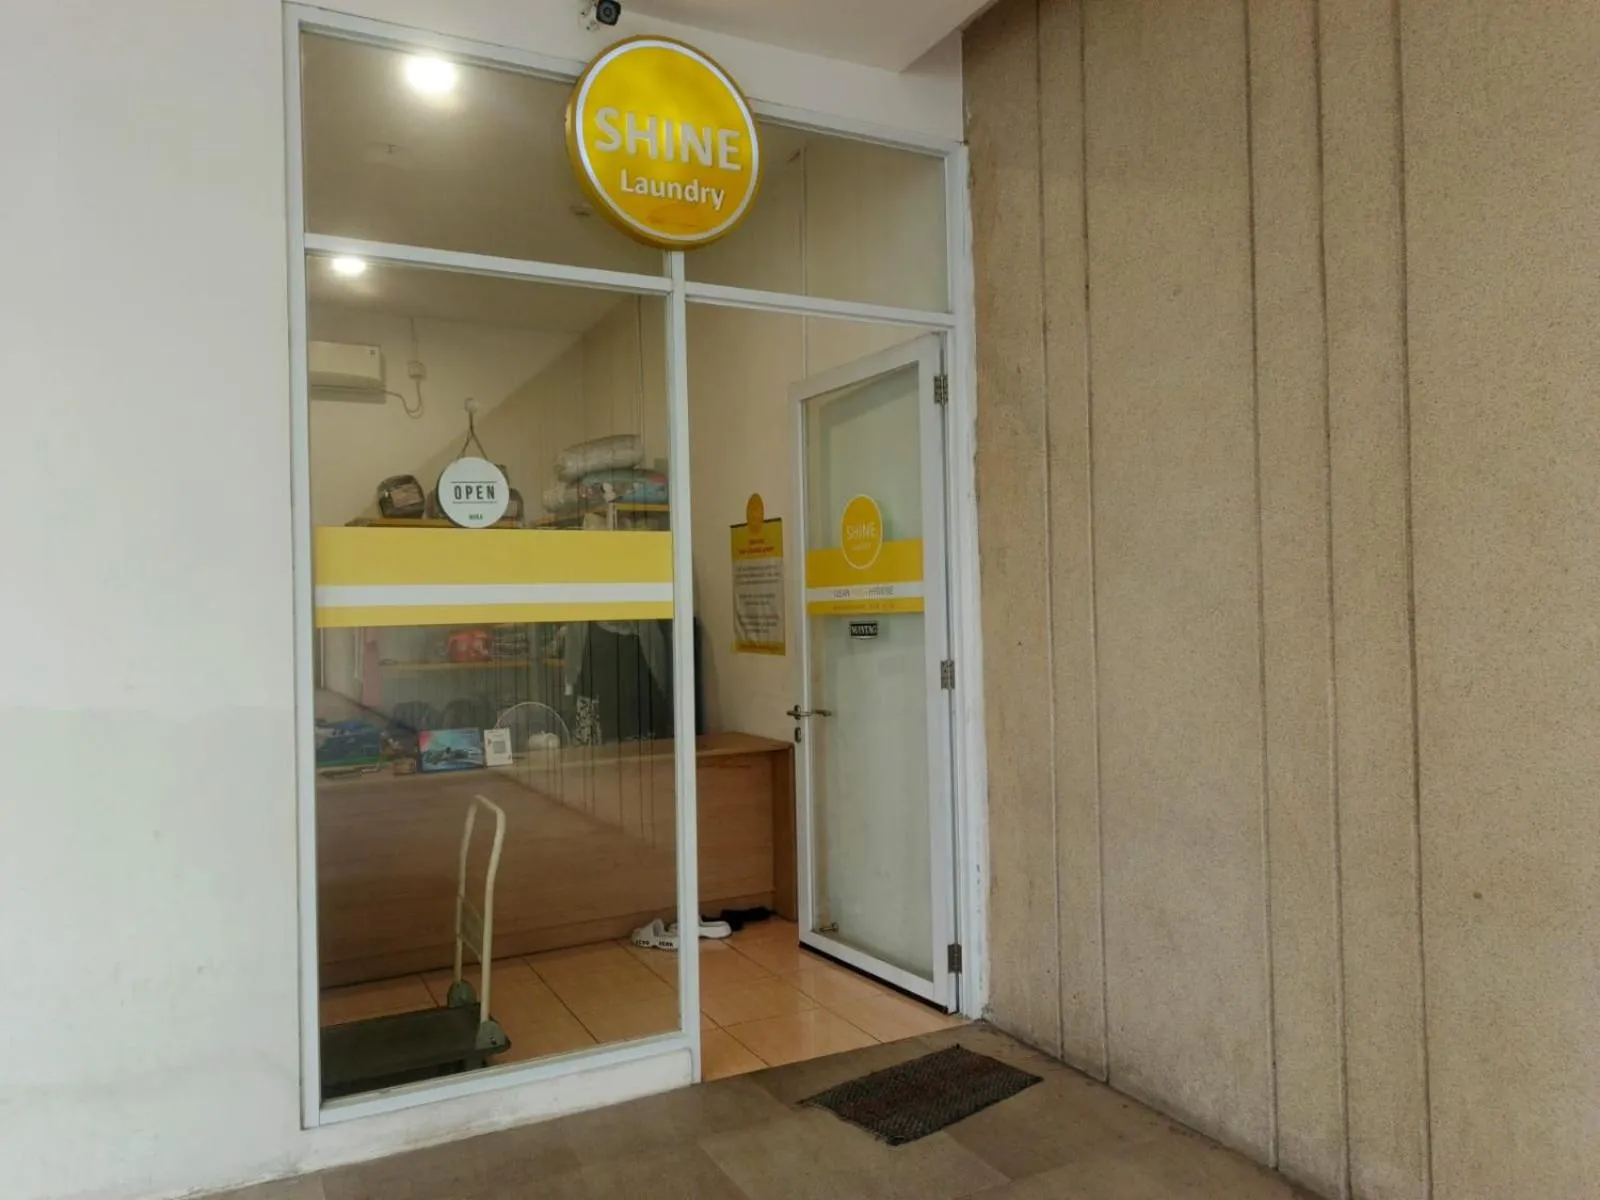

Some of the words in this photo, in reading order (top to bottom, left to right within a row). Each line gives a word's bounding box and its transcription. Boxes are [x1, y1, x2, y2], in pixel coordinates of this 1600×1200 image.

[595, 106, 741, 171] SHINE
[621, 168, 725, 211] Laundry
[454, 484, 495, 501] OPEN
[846, 522, 877, 541] SHINE
